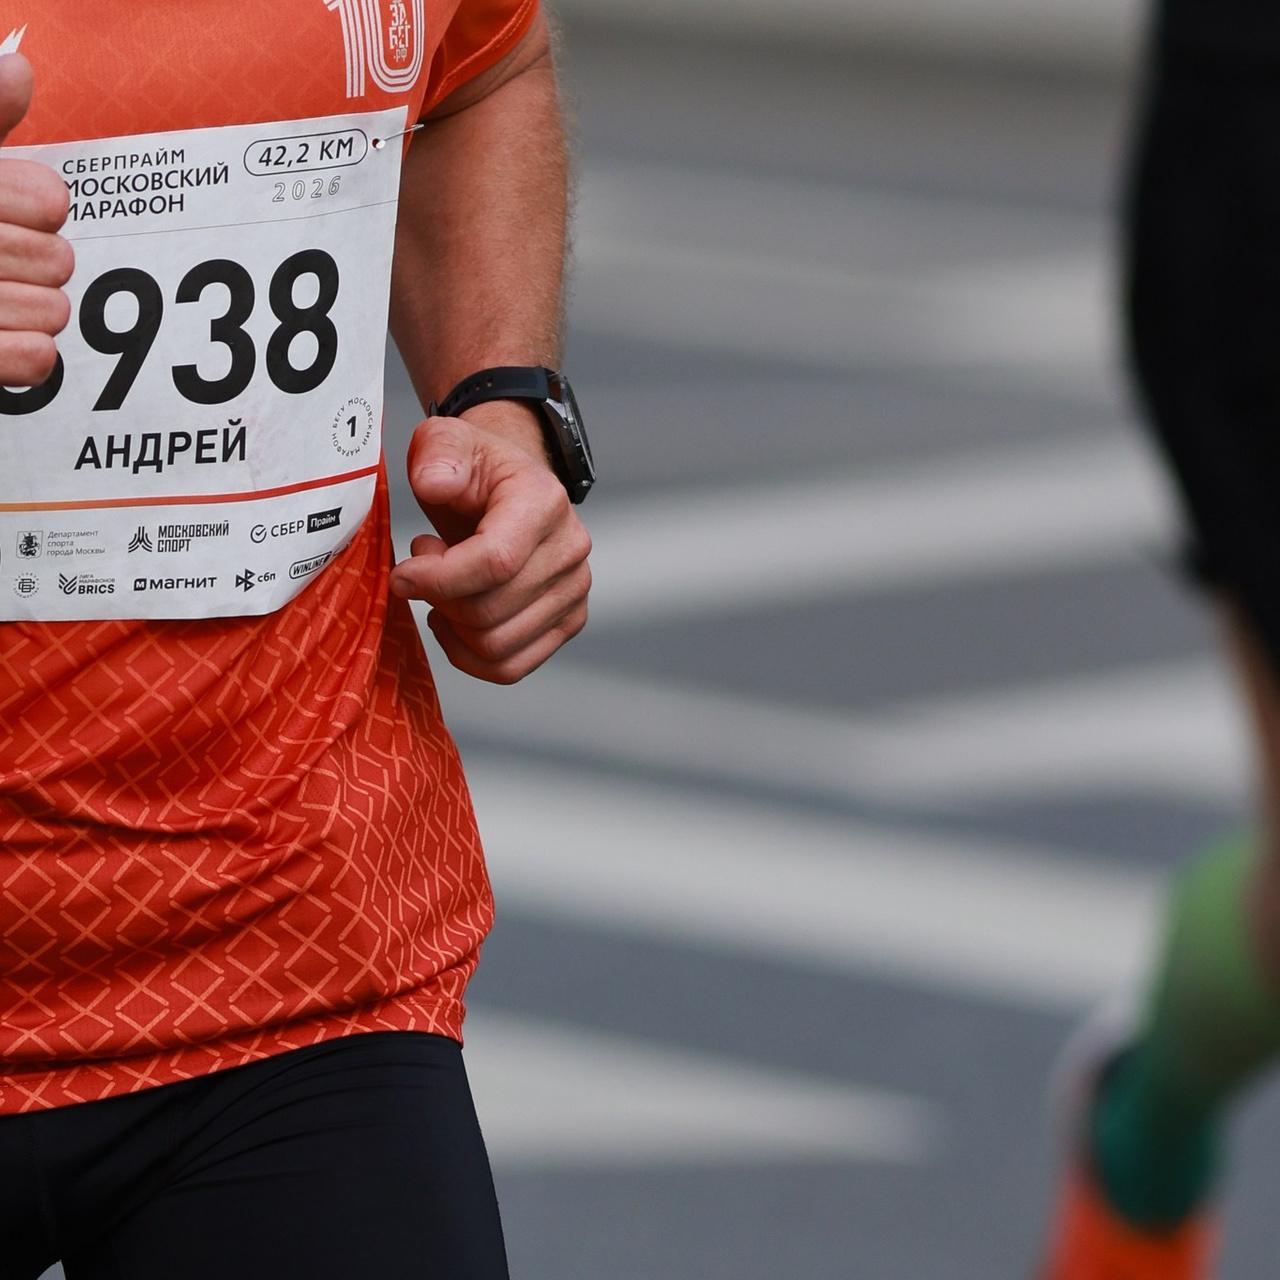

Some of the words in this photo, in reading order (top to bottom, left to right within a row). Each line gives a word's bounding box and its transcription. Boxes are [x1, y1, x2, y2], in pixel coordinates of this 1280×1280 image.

[258, 143, 310, 167] 42,2
[320, 136, 354, 161] КМ
[62, 148, 185, 174] СБЕРПРАЙМ
[272, 176, 341, 202] 2026
[346, 415, 357, 438] 1
[74, 418, 247, 475] АНДРЕЙ
[157, 520, 229, 539] МОСКОВСКИЙ
[270, 520, 304, 538] СБЕР
[310, 514, 336, 528] Прайм
[47, 530, 99, 540] Департамент
[47, 540, 74, 549] спорта
[157, 539, 191, 553] СПОРТ
[46, 548, 74, 558] города
[149, 577, 218, 590] магнит
[257, 572, 276, 583] сбп
[78, 584, 115, 595] BRICS
